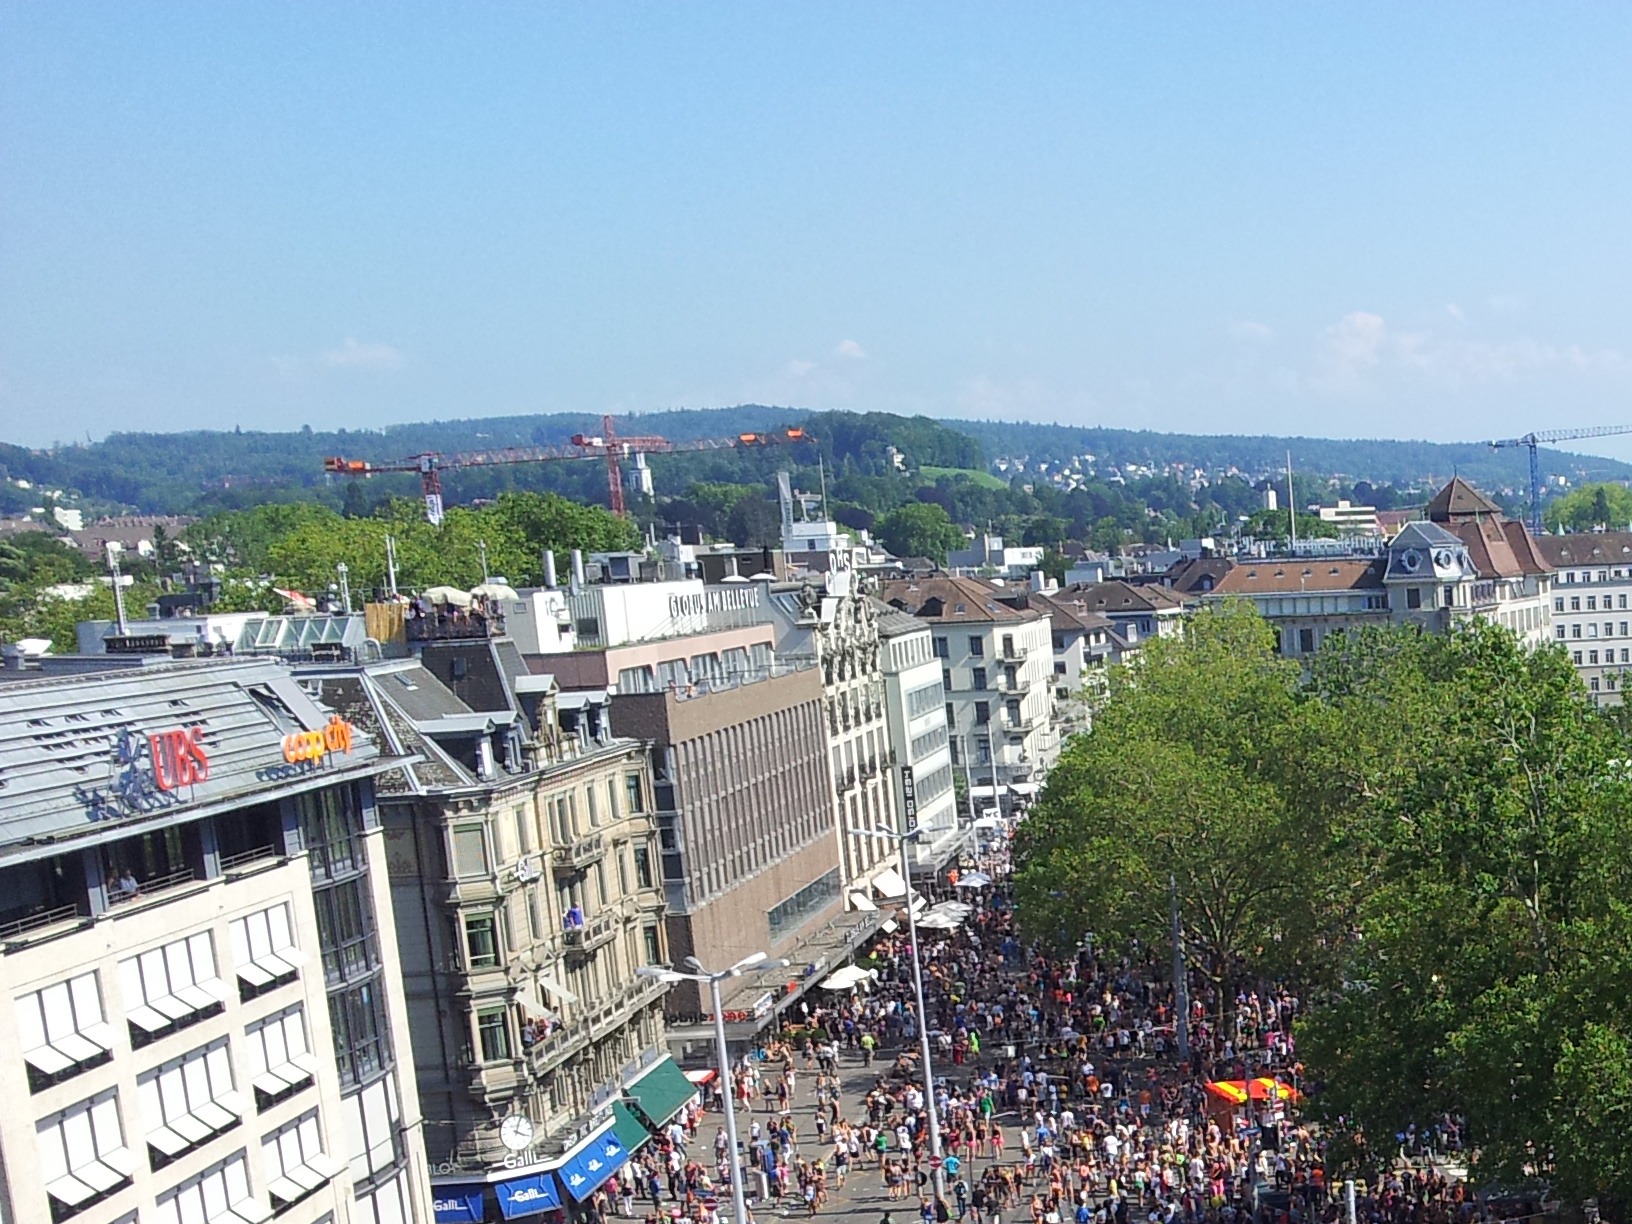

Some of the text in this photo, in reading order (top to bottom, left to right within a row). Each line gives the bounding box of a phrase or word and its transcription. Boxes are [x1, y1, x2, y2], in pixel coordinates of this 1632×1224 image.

[669, 587, 760, 617] GLOBUS AM BELLEVUE
[150, 725, 209, 790] UBS
[281, 714, 352, 765] coop city
[984, 810, 999, 818] WC
